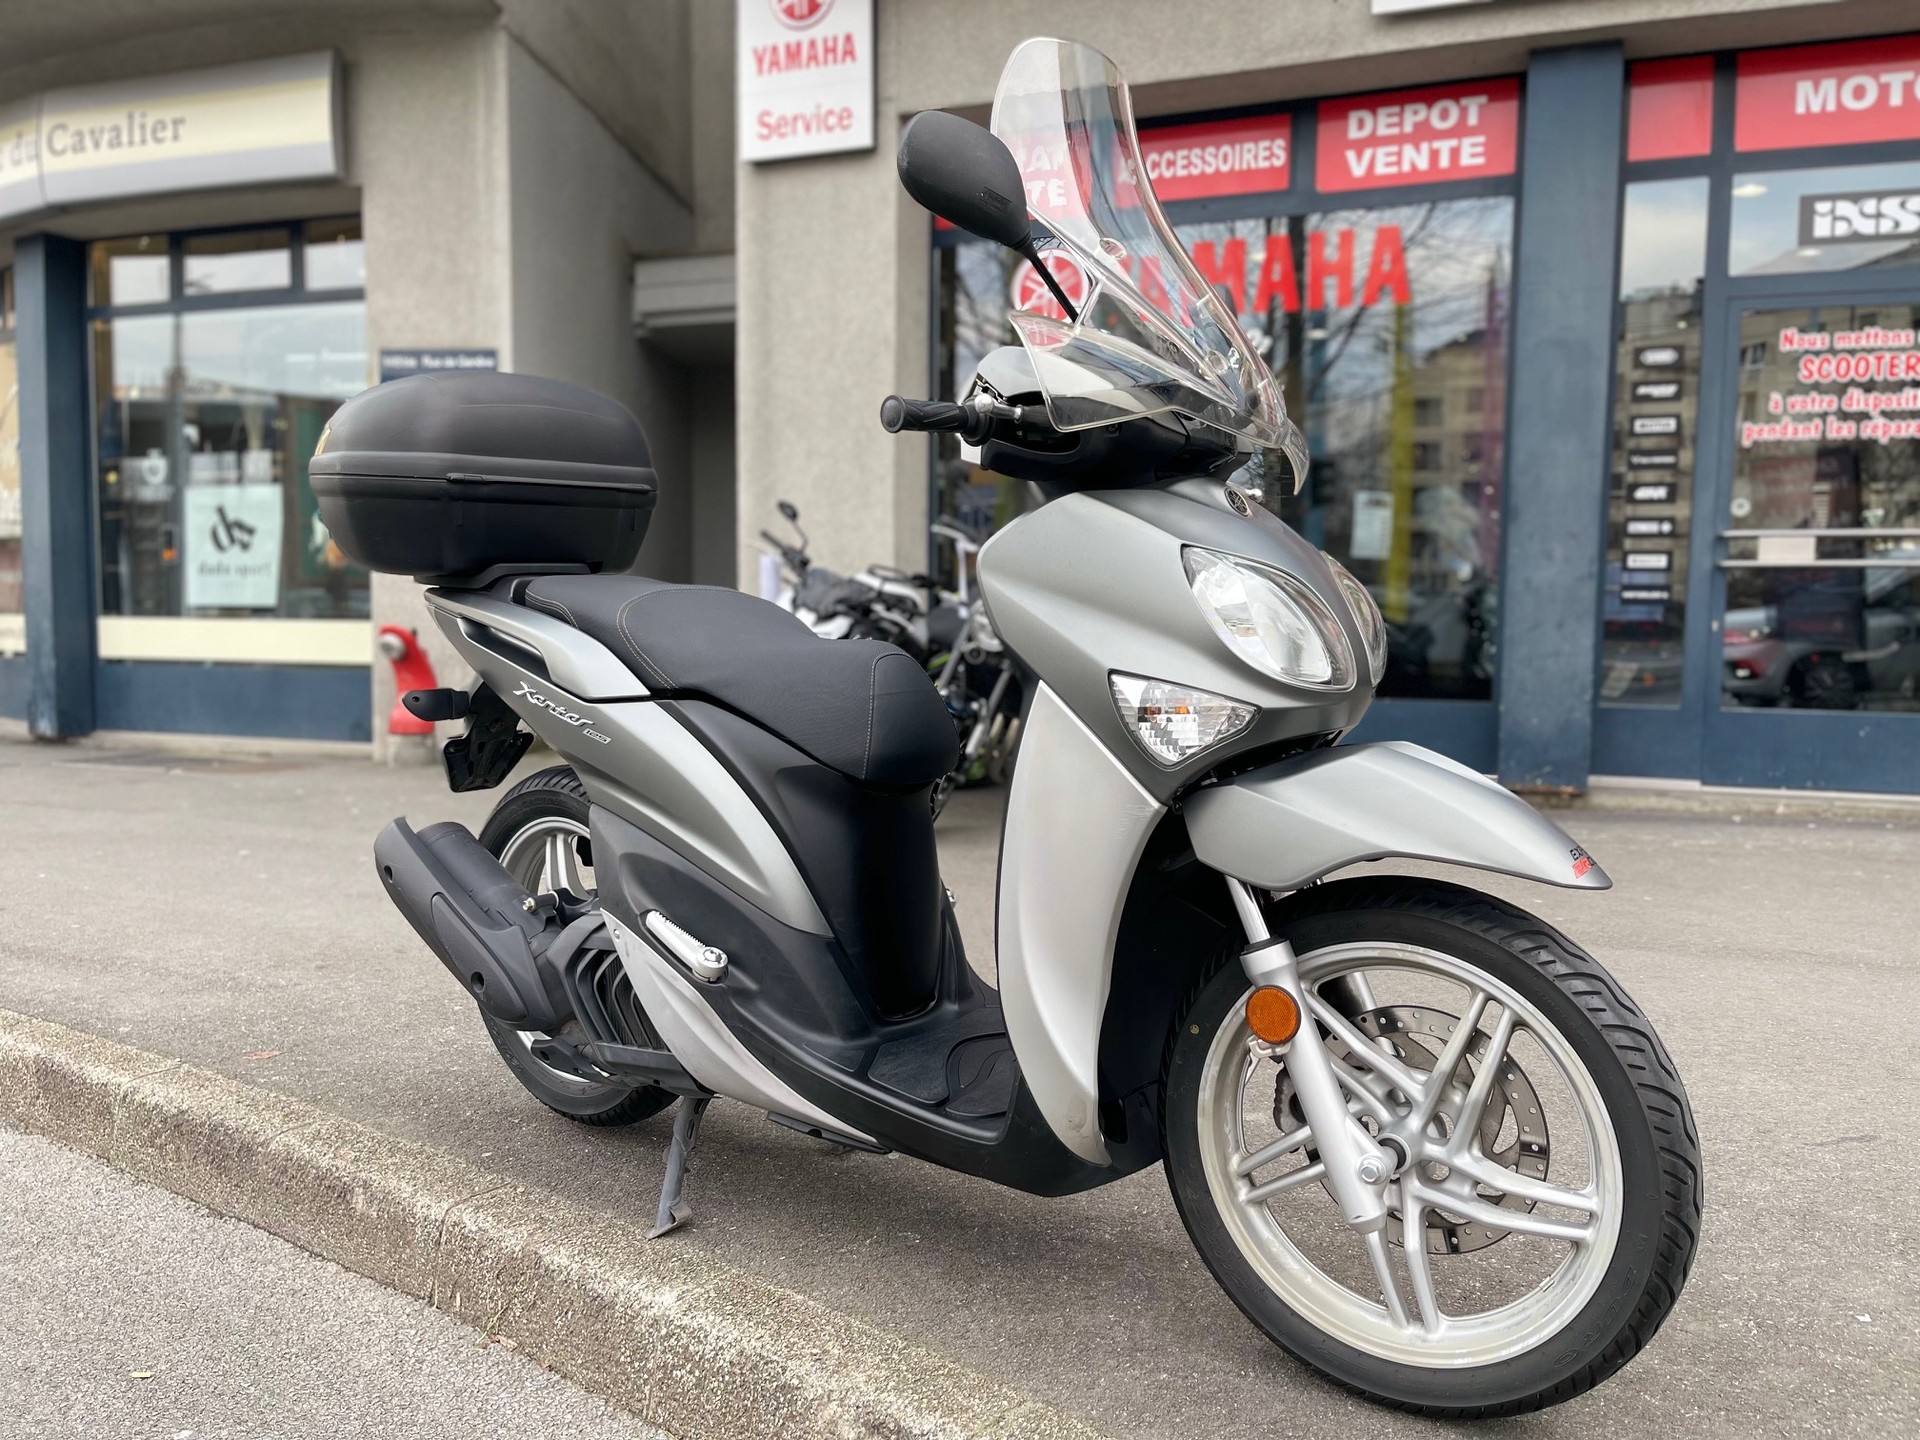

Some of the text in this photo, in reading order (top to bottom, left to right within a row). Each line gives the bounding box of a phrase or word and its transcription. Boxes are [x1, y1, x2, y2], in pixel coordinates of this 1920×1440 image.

[752, 32, 857, 76] YAMAHA
[1795, 71, 1920, 115] MOT
[46, 110, 187, 157] Cavalier
[756, 102, 854, 141] Service
[1347, 94, 1488, 140] DEPOT
[1345, 135, 1486, 178] VENTE
[1781, 328, 1915, 351] Nous mettons
[1786, 391, 1838, 413] votre
[1742, 416, 1822, 447] pendant
[1826, 415, 1857, 438] les
[513, 681, 594, 726] Xenter
